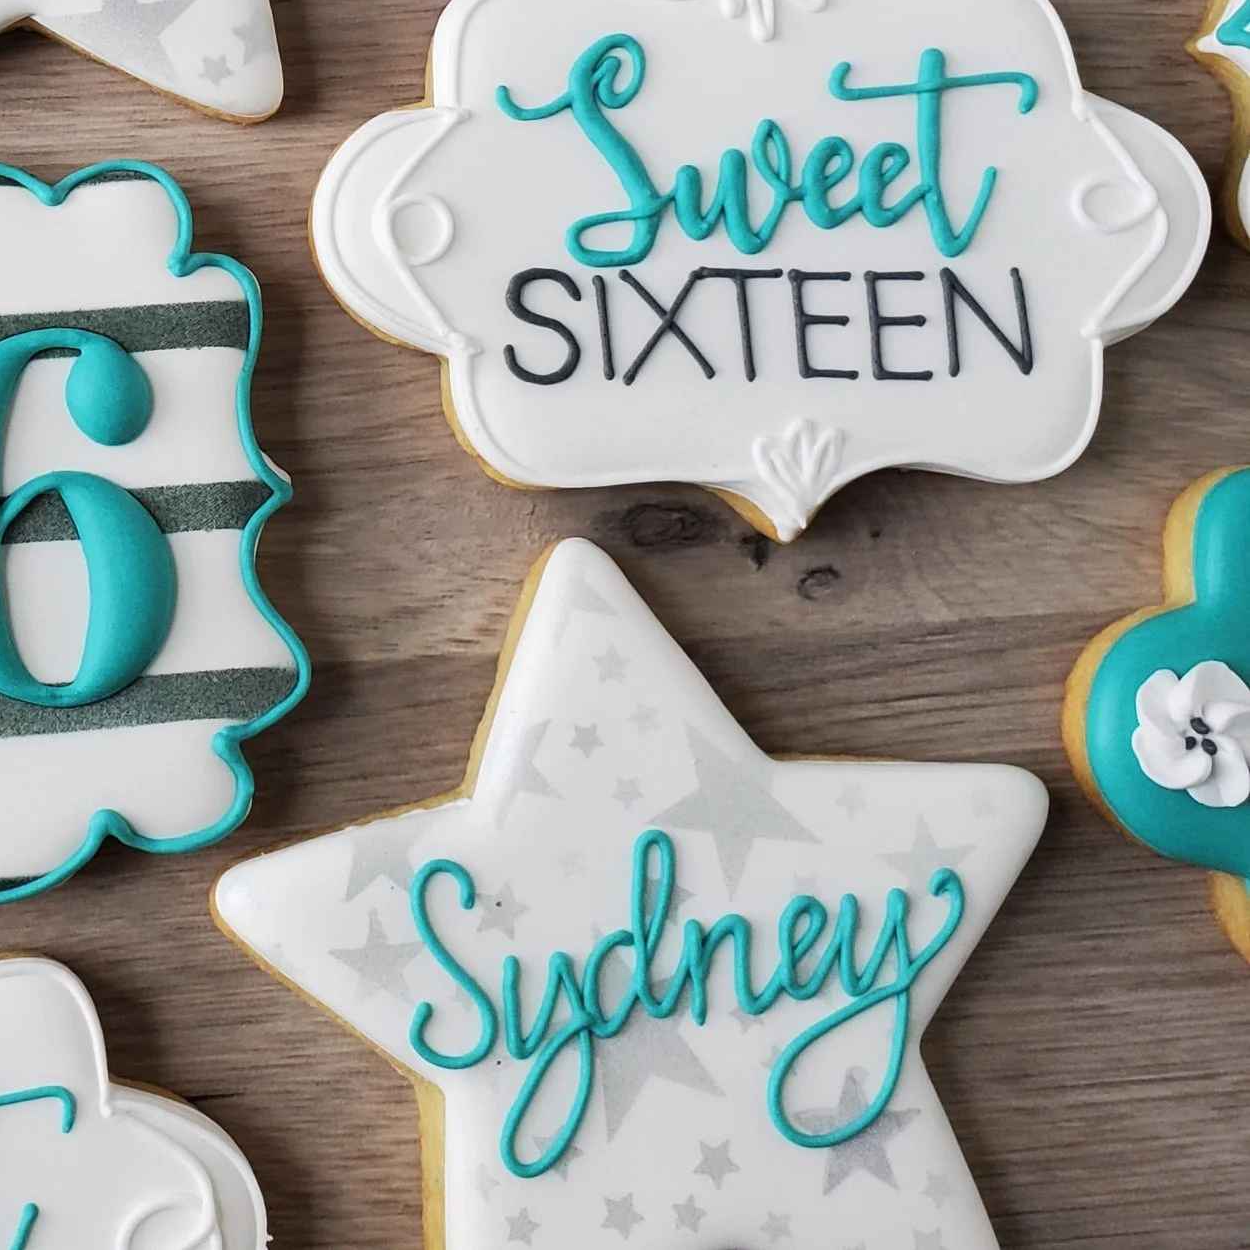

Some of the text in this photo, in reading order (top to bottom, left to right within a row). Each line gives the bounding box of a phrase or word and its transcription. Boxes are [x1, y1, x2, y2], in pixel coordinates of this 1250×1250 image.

[495, 33, 1040, 269] Sweet
[503, 265, 1035, 387] SIXTEEN
[408, 829, 966, 1180] Sydney
